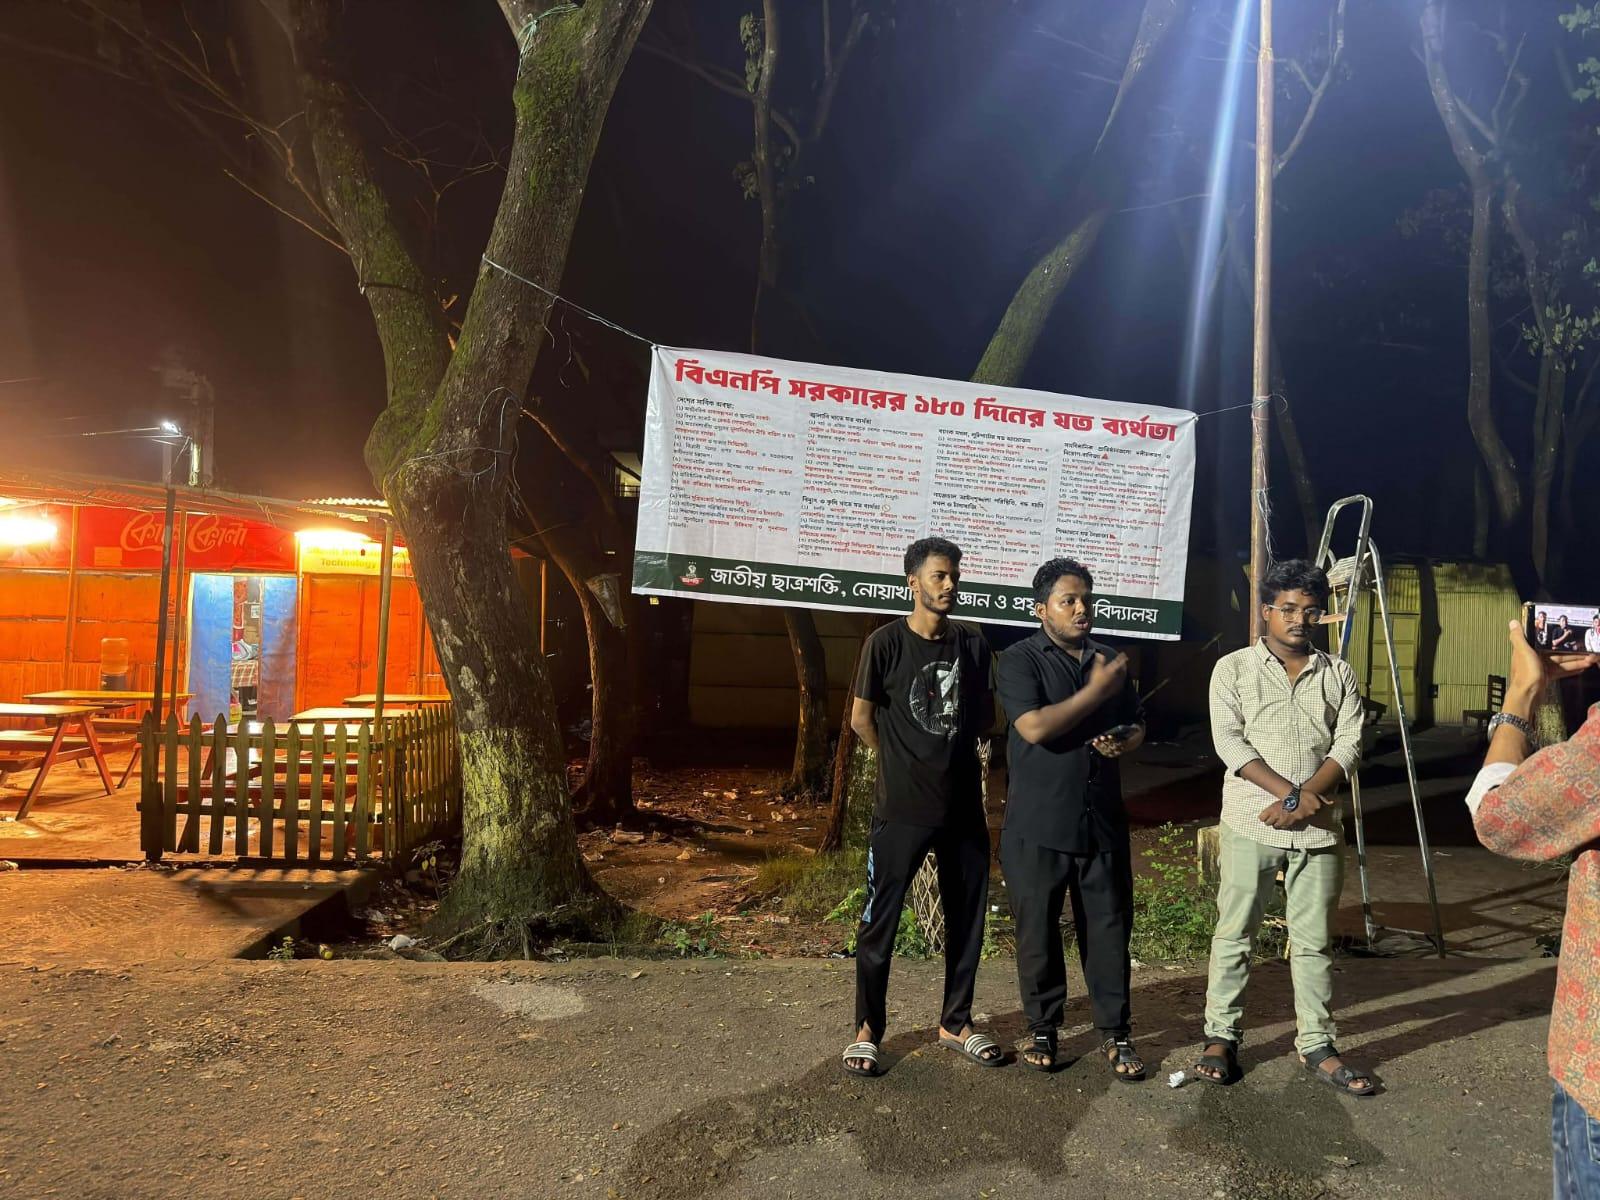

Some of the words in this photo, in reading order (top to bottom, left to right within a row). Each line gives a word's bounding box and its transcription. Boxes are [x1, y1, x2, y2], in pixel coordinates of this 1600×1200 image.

[676, 360, 779, 393] বিএনপি
[790, 380, 905, 410] সরকারের
[915, 397, 964, 415] ১৮০
[976, 399, 1044, 427] দিনের
[1056, 413, 1092, 431] যত
[1104, 419, 1174, 440] ব্যর্থতা
[187, 514, 247, 552] কোলা
[320, 558, 377, 569] Technology
[710, 561, 767, 589] জাতীয়
[771, 567, 846, 598] ছাত্রশক্তি,
[852, 577, 914, 601] নোয়াখা
[956, 591, 990, 608] জ্ঞান
[994, 594, 1006, 610] ও
[1011, 596, 1037, 617] প্রযু
